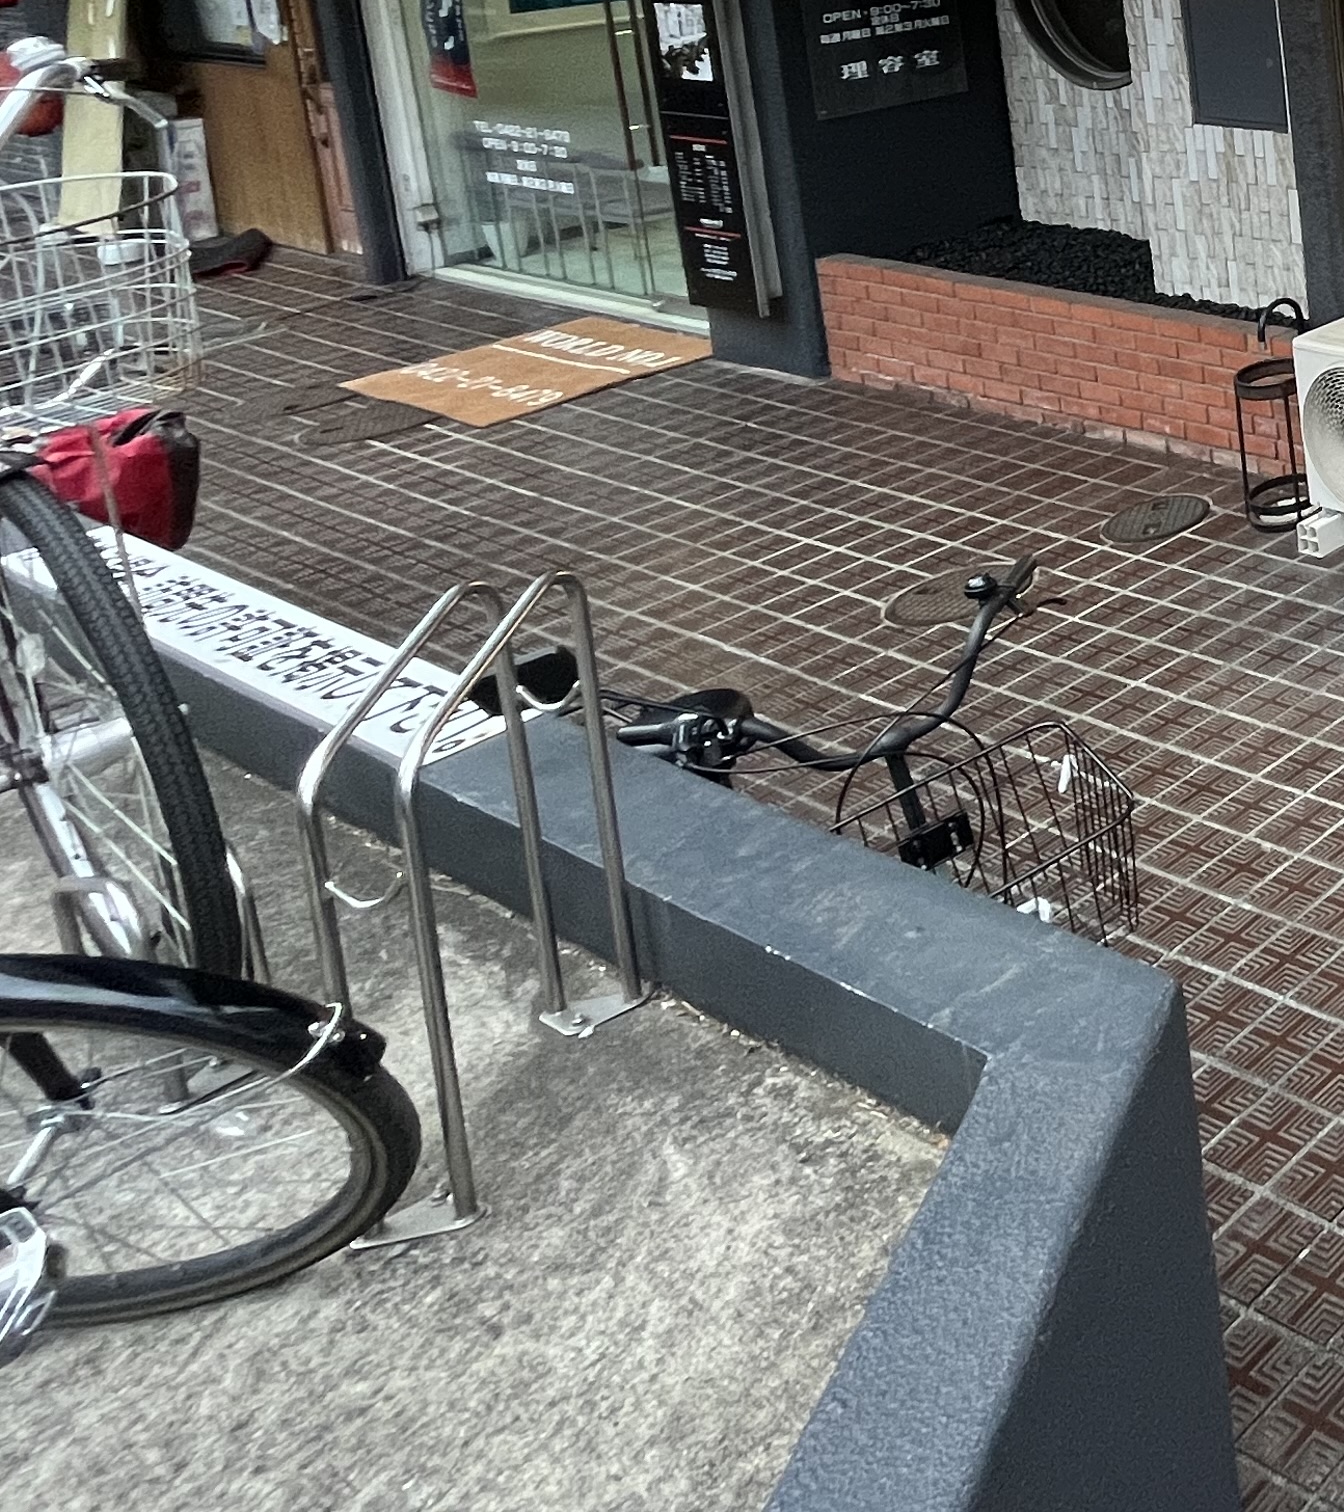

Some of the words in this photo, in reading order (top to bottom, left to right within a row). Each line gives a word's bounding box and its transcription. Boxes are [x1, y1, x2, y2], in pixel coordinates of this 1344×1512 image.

[840, 49, 941, 81] 理容室
[525, 330, 626, 358] WORLD
